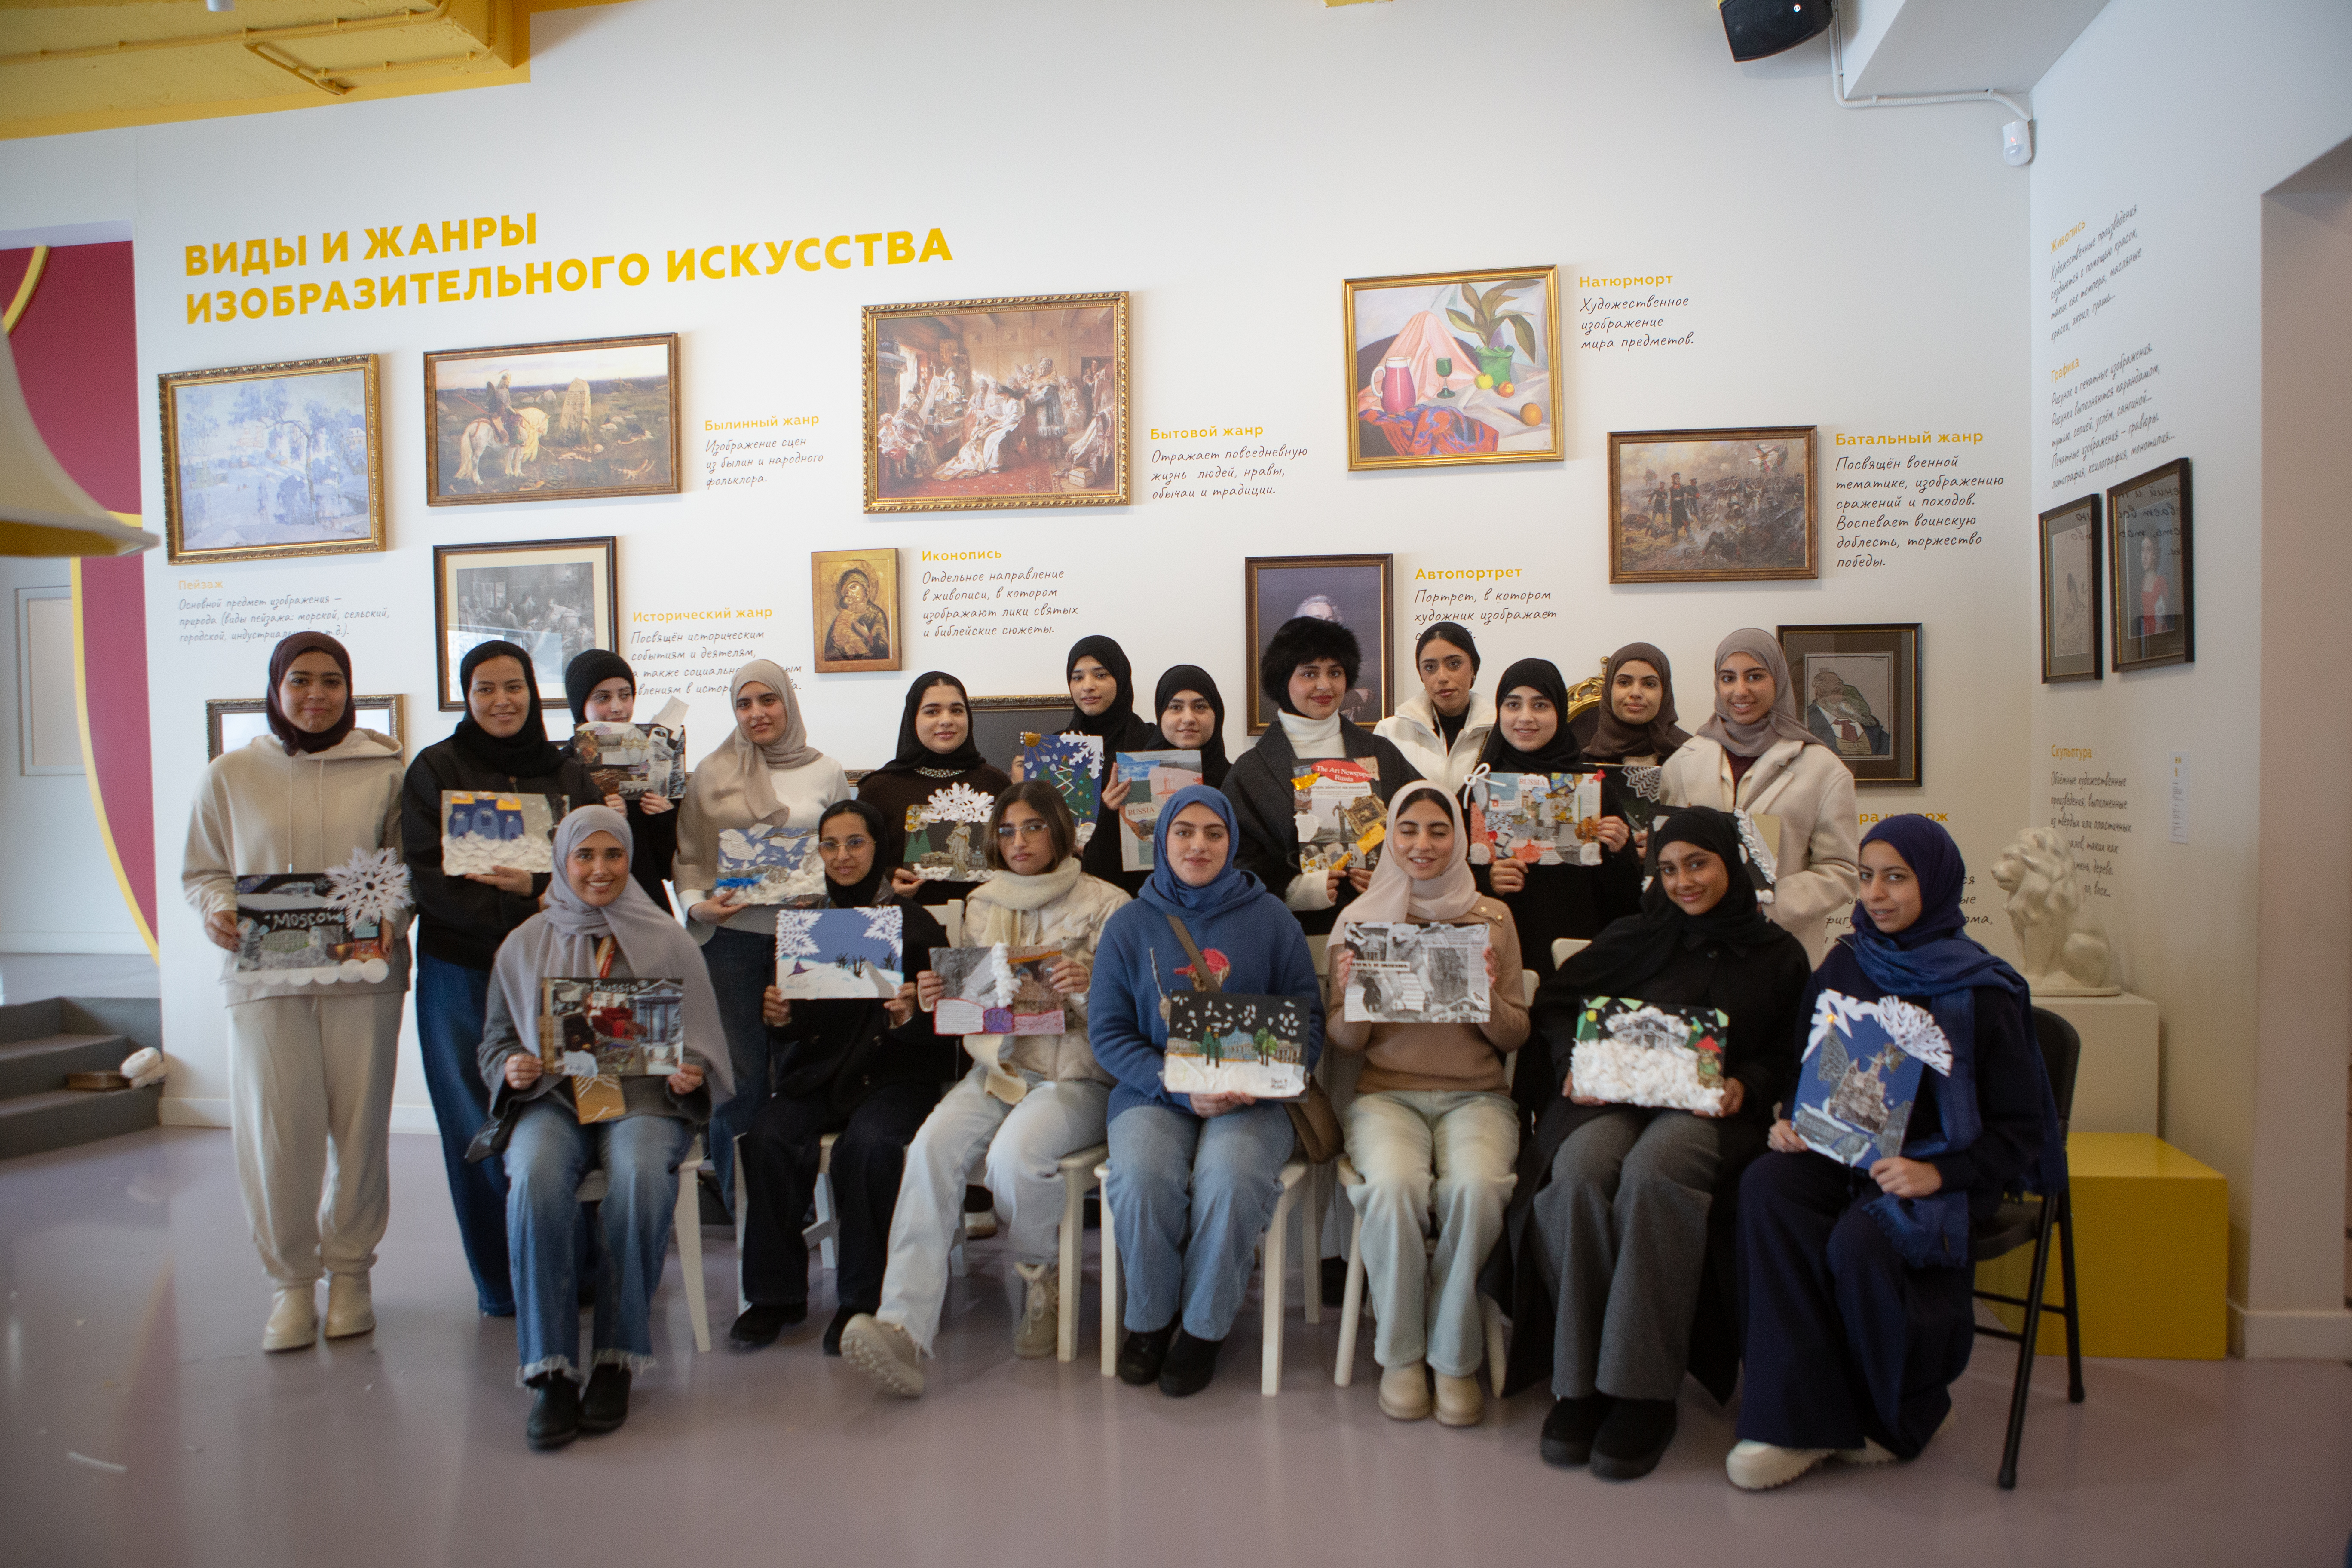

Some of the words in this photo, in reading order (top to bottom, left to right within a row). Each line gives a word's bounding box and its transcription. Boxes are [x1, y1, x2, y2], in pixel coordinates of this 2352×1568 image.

[185, 236, 307, 277] ВИДЫ
[323, 231, 349, 263] И
[363, 213, 537, 260] ЖАНРЫ
[2050, 238, 2095, 282] Художественные
[2098, 204, 2137, 246] произведения
[2051, 220, 2085, 254] Живопись
[2086, 247, 2112, 273] помощью
[185, 253, 647, 325] ИЗОБРАЗИТЕЛЬНОГО
[667, 228, 953, 284] ИСКУССТВА
[1580, 276, 1673, 289] Натюрморт
[2051, 303, 2067, 320] таких
[2069, 294, 2079, 307] как
[2110, 248, 2141, 278] масляные
[1580, 295, 1689, 314] Художественное
[1581, 317, 1663, 335] изображение
[1581, 340, 1615, 352] мира
[1621, 331, 1694, 351] предметов.
[2051, 358, 2079, 383] Графика
[2052, 388, 2073, 408] Рисунок
[2080, 368, 2108, 392] печатные
[705, 416, 778, 431] Былинный
[783, 416, 819, 427] жанр
[1151, 426, 1217, 440] Бытовой
[1223, 426, 1263, 438] жанр
[1836, 431, 1932, 445] Батальный
[1938, 432, 1983, 445] жанр
[706, 439, 777, 456] Изображение
[782, 438, 806, 448] сцен
[1152, 450, 1219, 466] Отражает
[1225, 444, 1308, 460] повседневную
[2052, 449, 2079, 470] Печатные
[2082, 430, 2118, 461] изображения
[706, 461, 717, 474] из
[721, 457, 753, 468] былин
[769, 452, 824, 468] народного
[1836, 456, 1901, 471] Посвящён
[1907, 455, 1959, 469] военной
[706, 475, 767, 490] фольклора.
[1152, 472, 1187, 485] жизнь
[1197, 466, 1237, 479] людей,
[1244, 463, 1285, 481] нравы,
[1152, 487, 1194, 499] обычаи
[1213, 484, 1276, 500] традиции.
[1836, 478, 1908, 490] тематике,
[1916, 475, 2003, 493] изображению
[1837, 496, 1902, 513] сражений
[1922, 493, 1975, 507] походов.
[1837, 514, 1908, 530] Воспевает
[1914, 513, 1976, 529] воинскую
[1837, 535, 1900, 548] доблесть,
[1908, 531, 1982, 550] торжество
[922, 550, 1002, 561] Иконопись
[1837, 554, 1885, 567] победы.
[923, 571, 984, 584] Отдельное
[989, 567, 1064, 583] направление
[1415, 568, 1522, 581] Автопортрет
[178, 579, 223, 590] Пейзаж
[923, 589, 930, 601] в
[932, 588, 989, 601] живописи,
[996, 586, 1004, 599] в
[1007, 589, 1057, 601] котором
[1415, 589, 1476, 606] Портрет,
[1484, 588, 1493, 601] в
[1496, 591, 1551, 604] котором
[179, 598, 221, 611] Основной
[227, 596, 266, 609] предмет
[270, 594, 330, 610] изображения
[179, 614, 217, 628] природа
[221, 612, 247, 627] (виды
[251, 612, 294, 626] пейзажа:
[298, 609, 340, 623] морской,
[344, 607, 389, 619] сельский,
[633, 608, 731, 623] Исторический
[736, 608, 772, 619] жанр
[923, 607, 996, 624] изображают
[1001, 609, 1028, 617] лики
[1034, 603, 1078, 616] святых
[1415, 609, 1475, 625] художник
[1481, 608, 1557, 625] изображает
[180, 630, 227, 644] городской,
[631, 631, 683, 644] Посвящён
[688, 631, 764, 644] историческим
[934, 625, 996, 637] библейские
[1002, 626, 1054, 635] сюжеты.
[631, 649, 685, 661] событиям
[701, 647, 756, 658] деятелям,
[636, 683, 681, 695] влениям
[686, 681, 693, 694] в
[2051, 744, 2092, 761] Скульптура
[1128, 807, 1155, 816] RUSSIA
[2107, 844, 2118, 854] как
